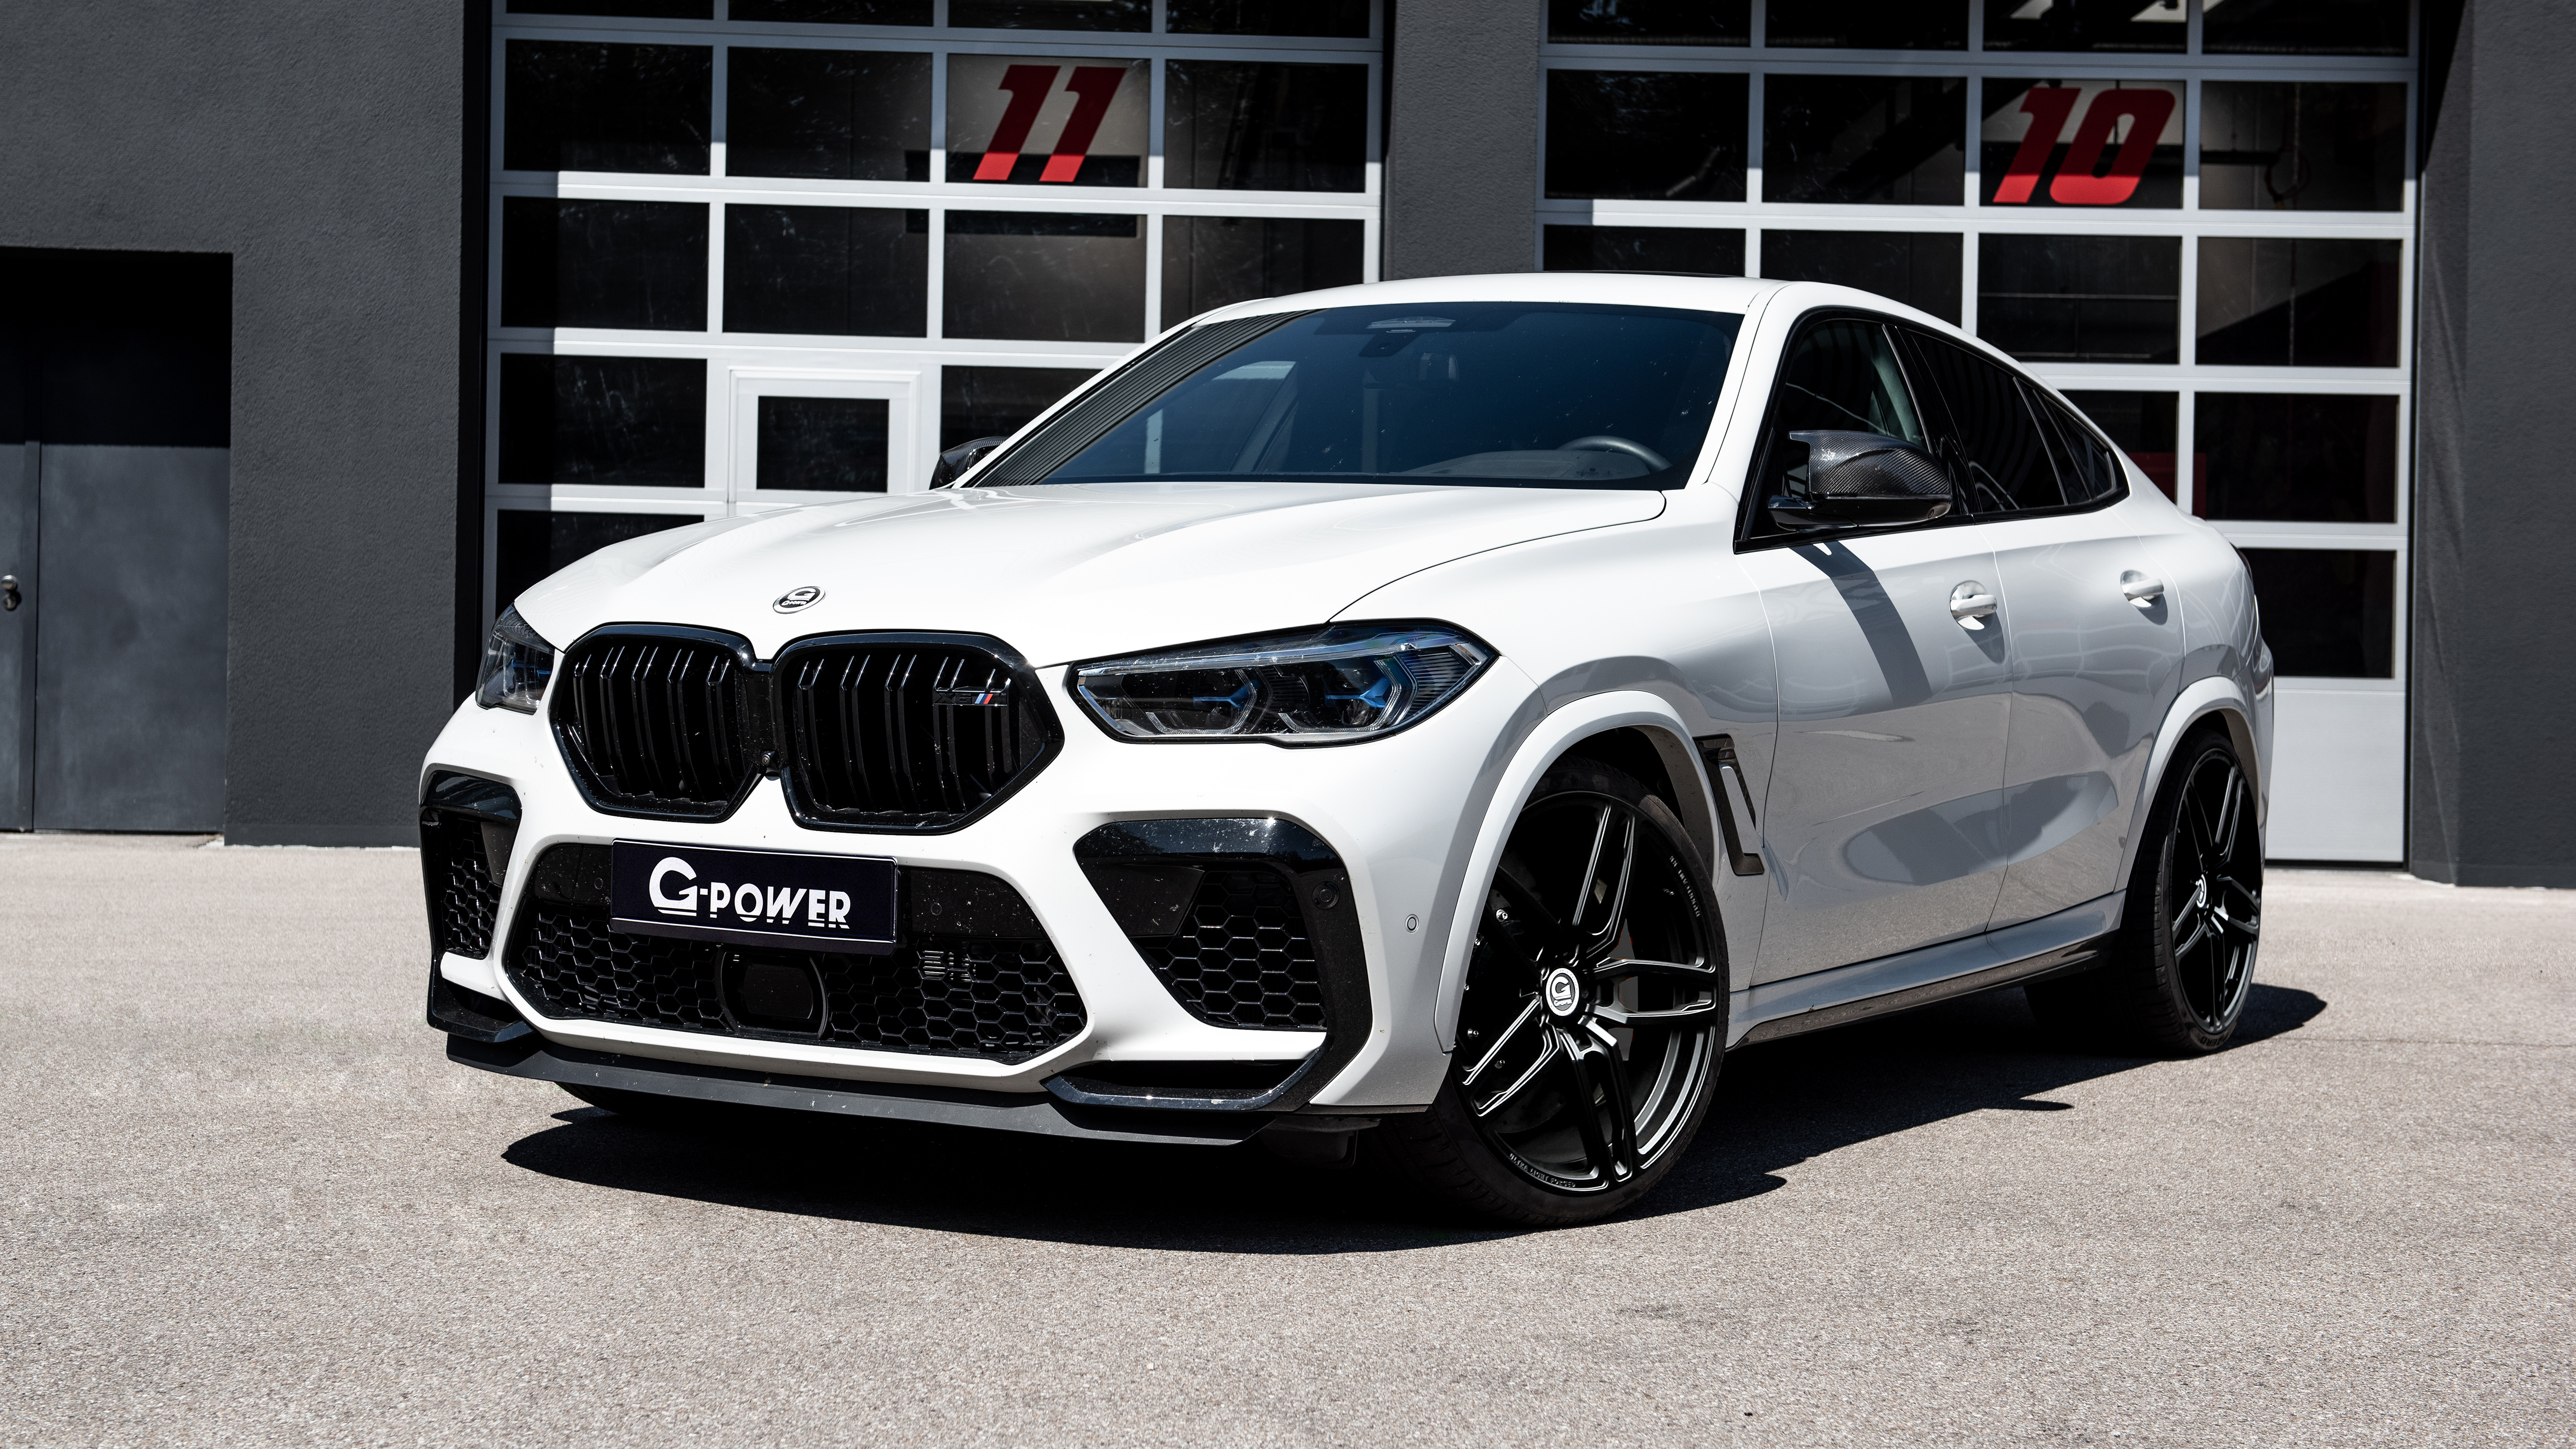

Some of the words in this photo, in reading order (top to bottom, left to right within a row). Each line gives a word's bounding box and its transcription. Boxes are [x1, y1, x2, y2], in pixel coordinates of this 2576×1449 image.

[972, 64, 1126, 183] 11
[1992, 87, 2176, 206] 10
[649, 856, 851, 929] G-POWER
